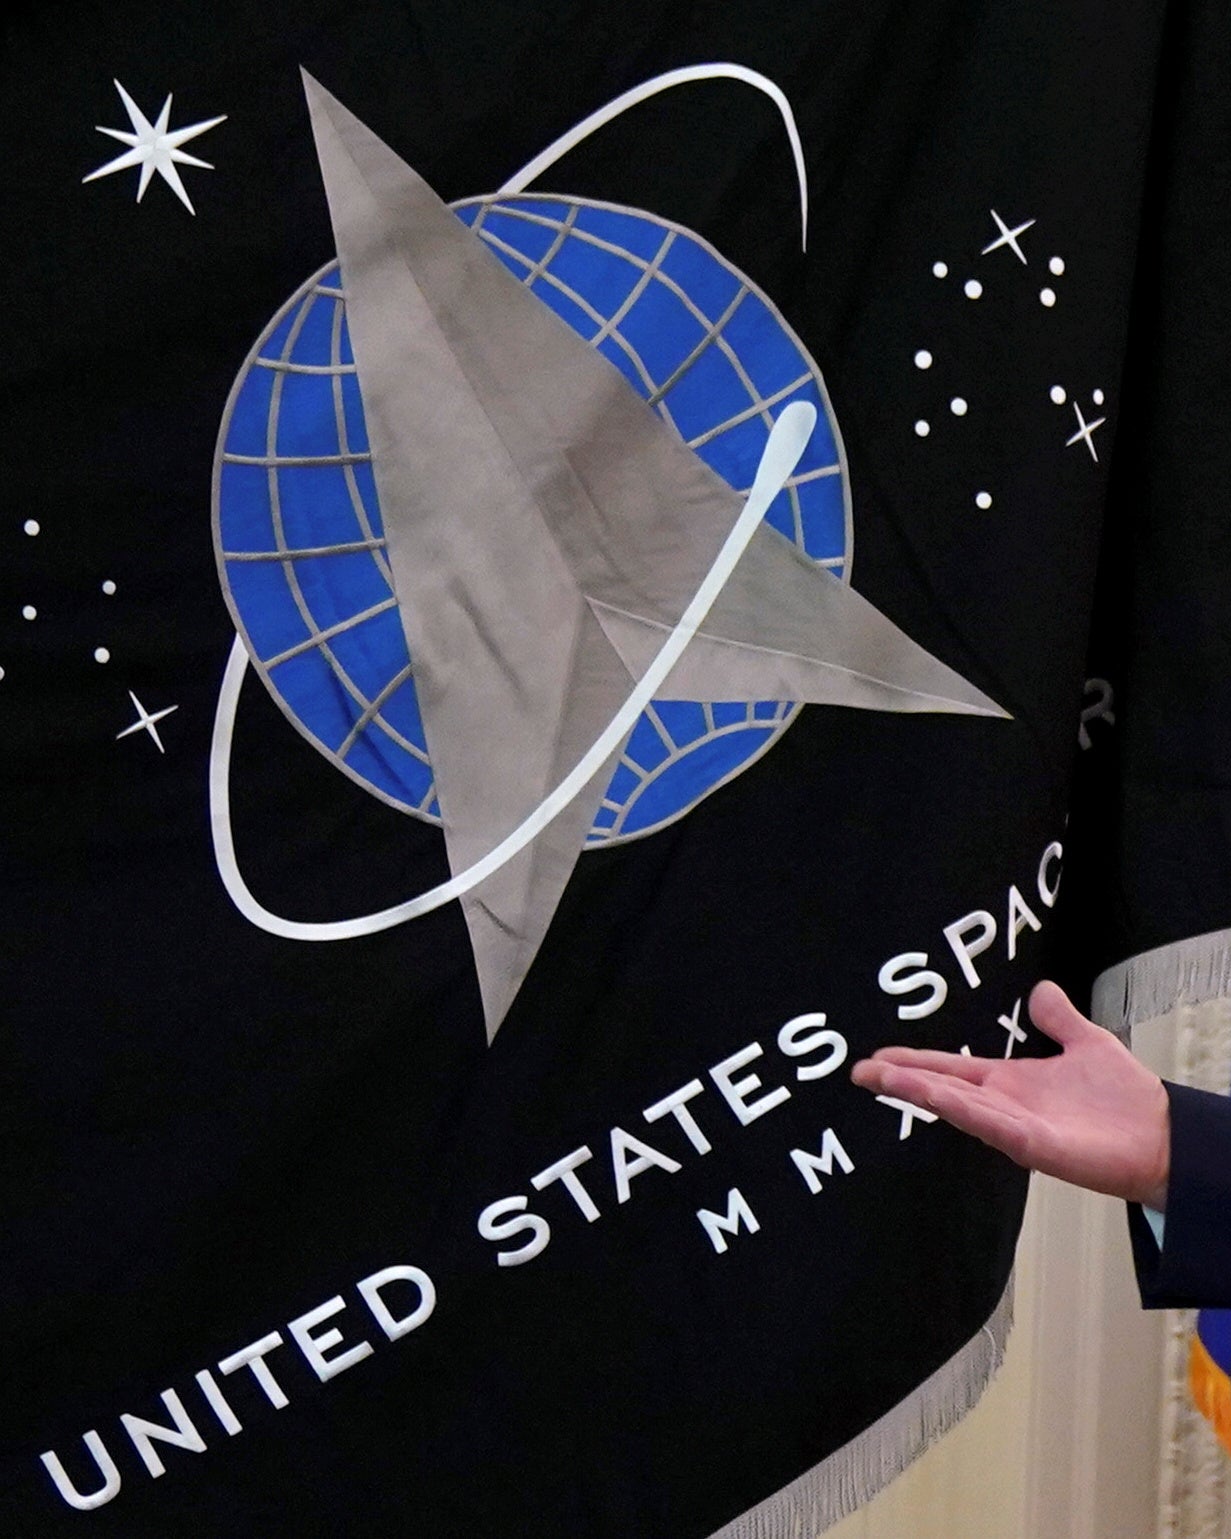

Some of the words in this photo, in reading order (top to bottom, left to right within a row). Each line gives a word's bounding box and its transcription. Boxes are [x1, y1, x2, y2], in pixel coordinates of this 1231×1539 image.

[40, 1265, 436, 1511] UNITED
[477, 1012, 848, 1267] STATES
[878, 813, 1068, 1020] SPAC
